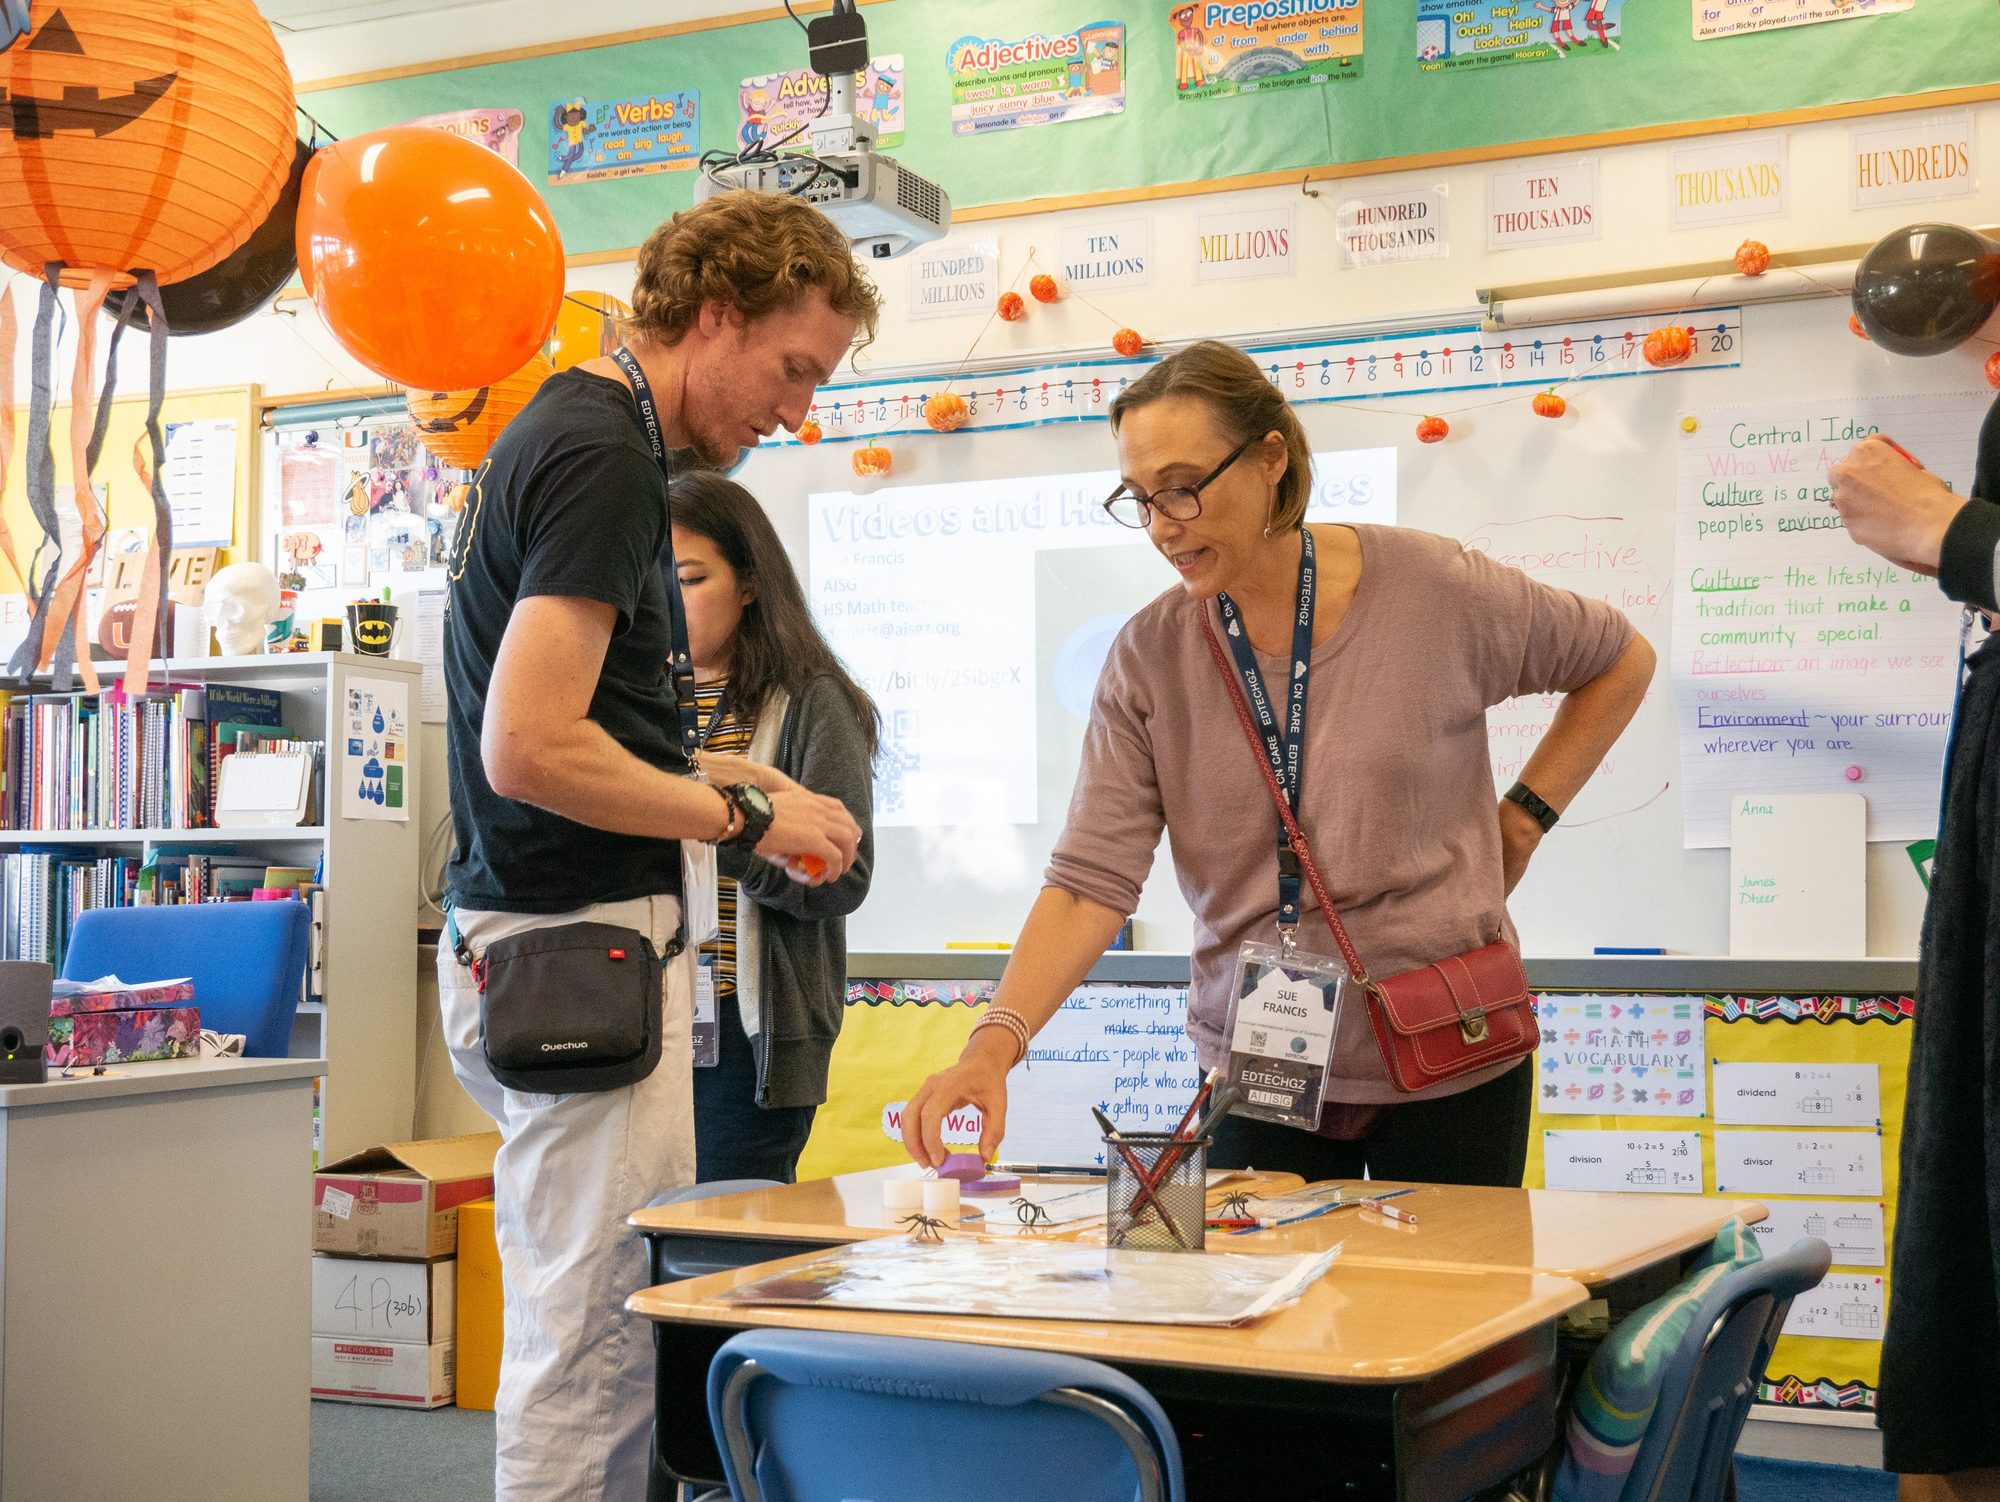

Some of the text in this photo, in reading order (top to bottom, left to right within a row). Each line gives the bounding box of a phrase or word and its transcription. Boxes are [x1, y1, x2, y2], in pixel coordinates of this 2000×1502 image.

[1421, 3, 1443, 11] show
[1454, 5, 1518, 23] Oh! Hey!
[1704, 6, 1763, 20] for or
[1257, 24, 1268, 32] tell
[1271, 21, 1296, 31] where
[1298, 17, 1329, 28] objects
[1459, 19, 1542, 36] Ouch! Hello!
[1700, 27, 1716, 35] Alex
[1718, 24, 1734, 32] and
[1736, 20, 1756, 29] Ricky
[1759, 16, 1786, 27] played
[1788, 13, 1807, 21] until
[1809, 11, 1822, 19] the
[1214, 24, 1358, 46] at from under behind
[1475, 33, 1528, 49] Look out!
[960, 37, 1078, 70] Adjectives
[1305, 44, 1329, 53] with
[1421, 62, 1443, 70] Yeah!
[1491, 55, 1514, 63] game!
[1515, 50, 1548, 59] Hooray!
[955, 78, 985, 87] describe
[988, 74, 1010, 83] nouns
[1013, 71, 1027, 79] and
[1209, 87, 1222, 96] ball
[1259, 81, 1270, 89] the
[1272, 77, 1295, 87] bridge
[1297, 75, 1309, 83] and
[965, 80, 1051, 99] sweet icy warm
[617, 99, 674, 124] Verbs
[972, 95, 1055, 115] juicy sunny blue
[598, 130, 609, 138] are
[611, 128, 630, 137] words
[633, 126, 639, 134] of
[641, 124, 661, 133] action
[771, 119, 801, 134] quickly
[975, 119, 1009, 129] lemonade
[604, 133, 682, 151] read sing laugh
[618, 143, 690, 159] am were
[1858, 142, 1968, 188] HUNDREDS
[1527, 177, 1558, 199] TEN
[1676, 163, 1780, 206] THOUSANDS
[1356, 202, 1427, 225] HUNDRED
[1494, 205, 1592, 233] THOUSANDS
[1087, 235, 1118, 253] TEN
[1200, 228, 1288, 263] MILLIONS
[1348, 228, 1435, 252] THOUSANDS
[922, 257, 984, 278] HUNDRED
[1065, 258, 1144, 281] MILLIONS
[921, 282, 984, 304] MILLIONS
[1295, 335, 1733, 387] 5 6 7 8 9 10 11 12 13 14 15 16 17 20
[628, 364, 662, 458] CARE EDTECHGZ
[1730, 420, 1810, 448] Central
[1707, 449, 1799, 477] Who We
[1703, 482, 1763, 505] Culture
[1774, 486, 1787, 501] is
[1798, 488, 1807, 500] a
[822, 501, 961, 542] Videos
[972, 490, 1048, 533] and
[1699, 513, 1763, 541] people's
[854, 550, 904, 565] Francis
[823, 580, 857, 592] AISG
[1299, 530, 1313, 626] CARE EDTECHGZ
[1785, 566, 1897, 587] the lifestyle
[824, 598, 886, 616] HS Math
[1697, 598, 1911, 617] tradition that make a
[1700, 625, 1796, 648] community
[1798, 656, 1944, 676] an image we see
[1246, 669, 1272, 726] EDTECHGZ
[1697, 684, 1766, 701] ourselves
[1291, 683, 1304, 733] CN CARE
[1698, 706, 1868, 734] Environment your
[1705, 738, 1814, 756] wherever you
[1268, 735, 1285, 784] CN CARE
[1741, 800, 1774, 816] Anna
[1739, 876, 1776, 888] James
[1739, 892, 1777, 904] Dheer
[1100, 993, 1170, 1015] something
[1277, 990, 1298, 1001] SUE
[1263, 1002, 1307, 1017] FRANCIS
[1105, 1020, 1139, 1035] makes
[541, 1042, 588, 1051] Quechua
[1595, 1035, 1649, 1048] MATH
[1123, 1046, 1187, 1069] people who
[1564, 1053, 1688, 1068] VOCABULARY
[1115, 1071, 1176, 1092] people who
[1241, 1071, 1307, 1091] EDTECHGZ
[1737, 1089, 1776, 1097] dividend
[1113, 1097, 1163, 1122] getting a
[1569, 1156, 1602, 1164] division
[1743, 1158, 1773, 1166] divisor
[387, 1295, 422, 1328] (306)
[343, 1346, 392, 1355] SCHOLASTIC
